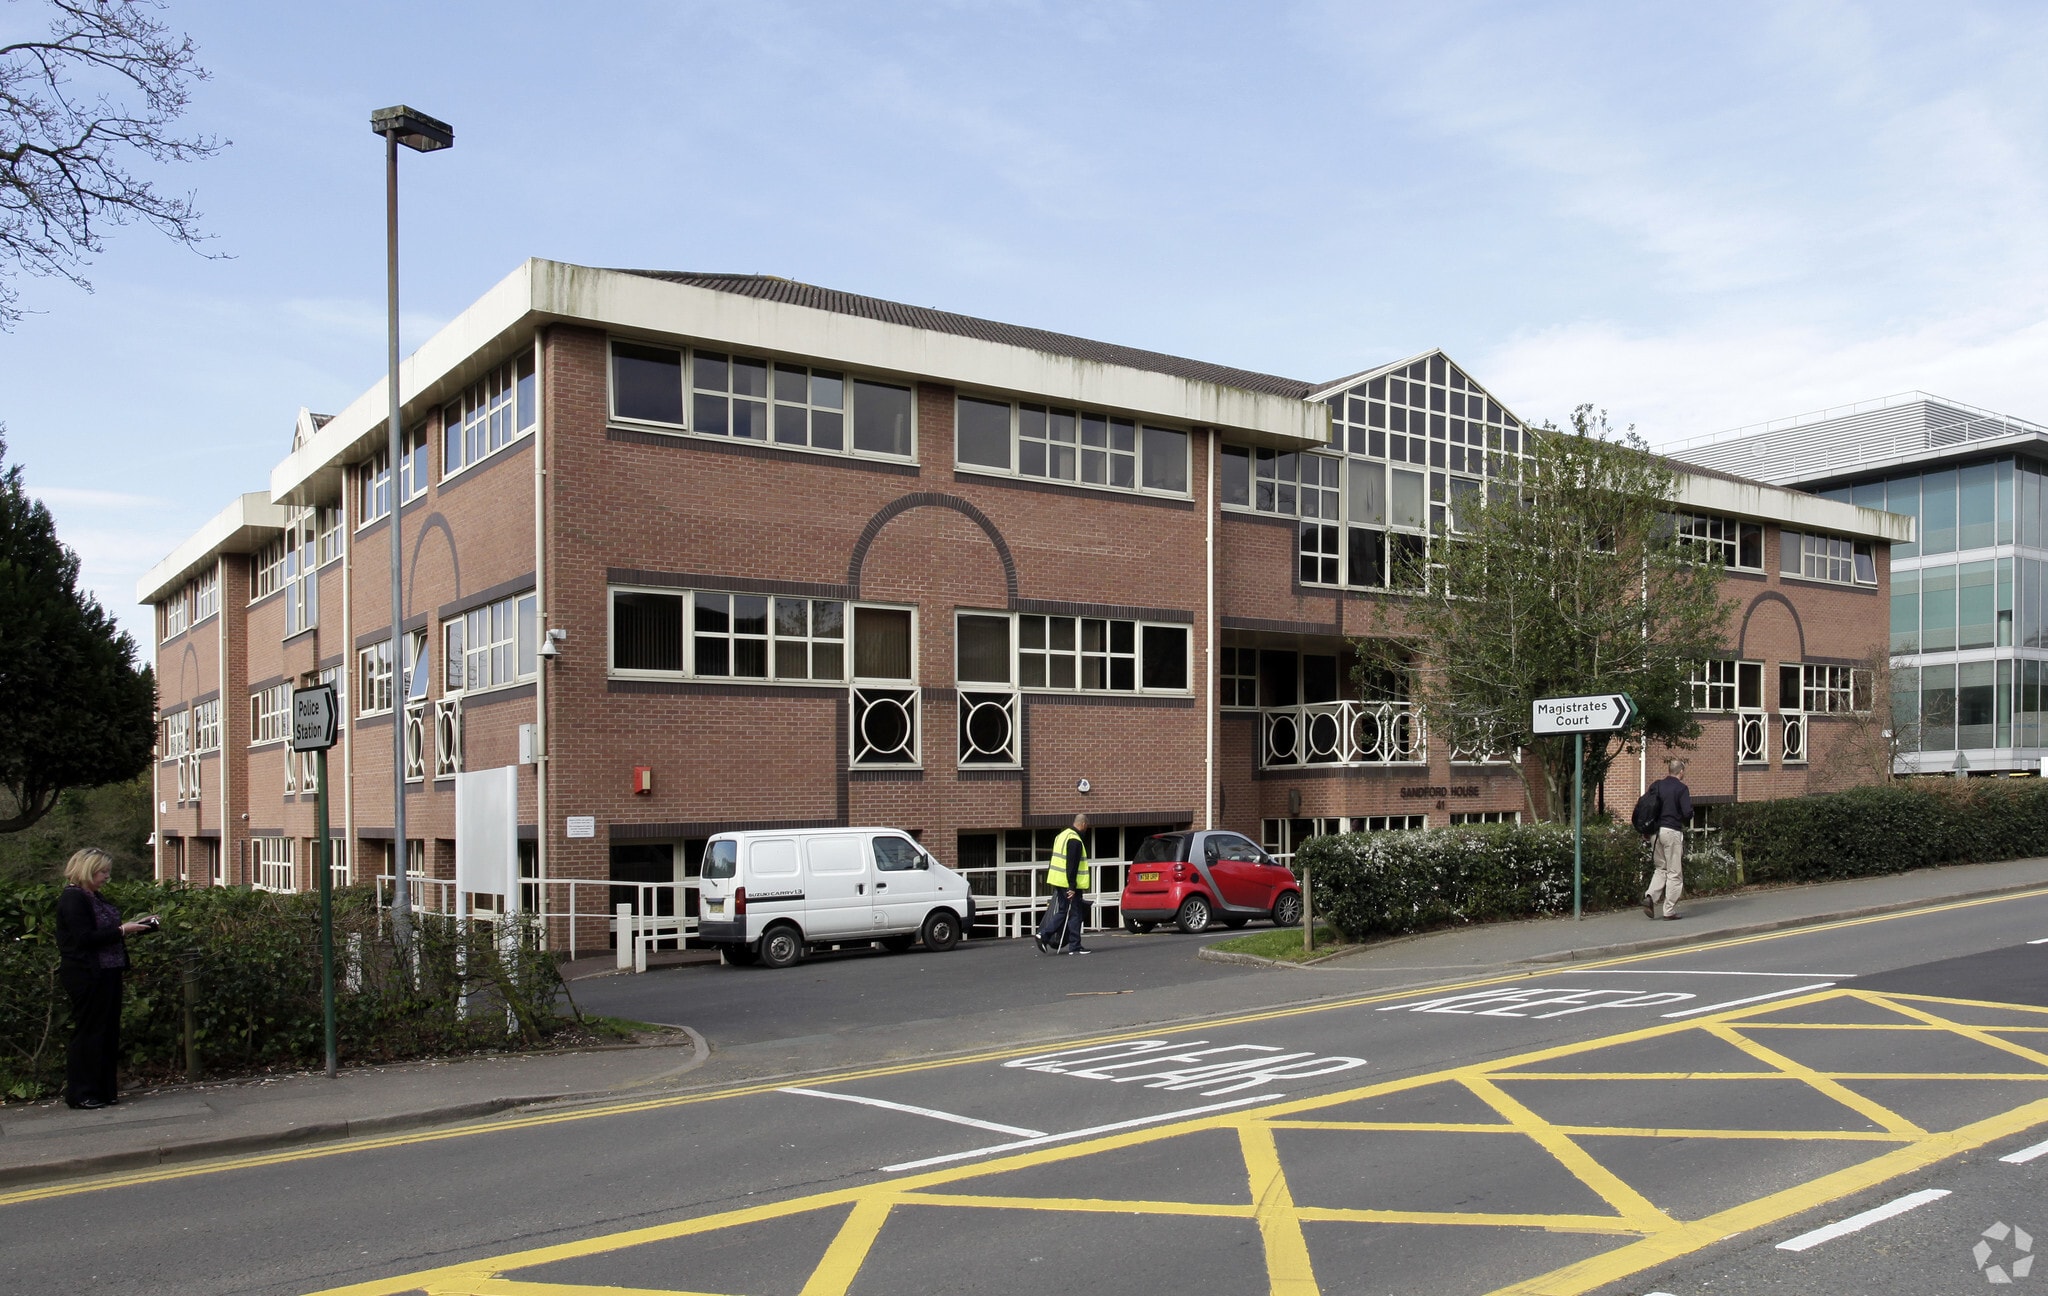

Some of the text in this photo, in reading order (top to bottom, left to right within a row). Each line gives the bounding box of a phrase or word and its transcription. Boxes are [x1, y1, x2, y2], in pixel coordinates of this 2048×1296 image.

[299, 699, 320, 717] Police
[1538, 702, 1608, 716] Magistrates
[1556, 715, 1590, 726] Court
[296, 722, 322, 740] Station
[1400, 786, 1480, 798] SANDFORD HOUSE
[1436, 800, 1445, 810] 41
[1375, 987, 1697, 1020] KEEP
[1000, 1040, 1369, 1098] CLEAR
